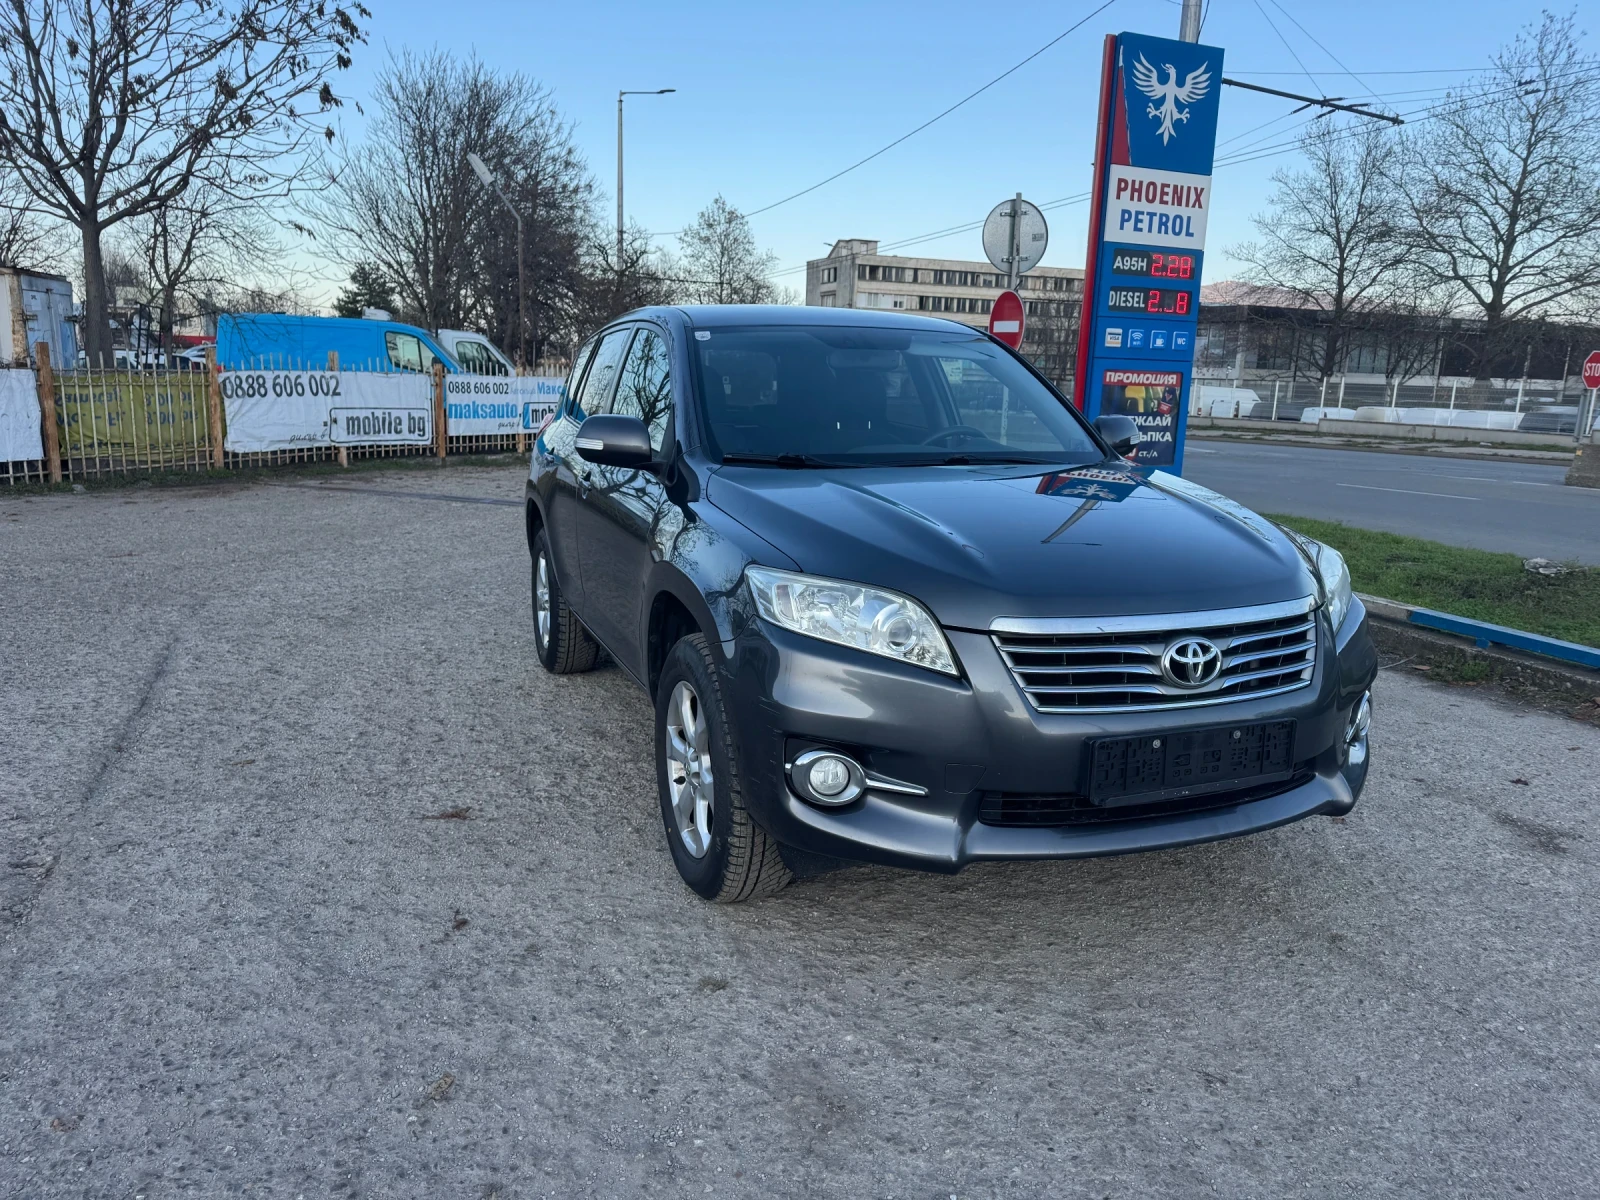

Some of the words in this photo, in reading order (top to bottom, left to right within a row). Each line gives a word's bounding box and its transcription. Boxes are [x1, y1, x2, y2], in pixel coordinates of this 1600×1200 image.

[1116, 178, 1205, 209] PHOENIX
[1119, 209, 1194, 237] PETROL
[1151, 254, 1191, 278] 2.28
[1108, 291, 1145, 307] DIESEL
[1106, 371, 1177, 385] ПРОМОЦИЯ
[1585, 363, 1600, 377] STO
[221, 375, 268, 399] 0888
[273, 374, 305, 397] 606
[308, 374, 341, 397] 002
[448, 381, 471, 394] 0888
[474, 382, 491, 394] 606
[493, 383, 509, 395] 002
[346, 412, 403, 436] mobile
